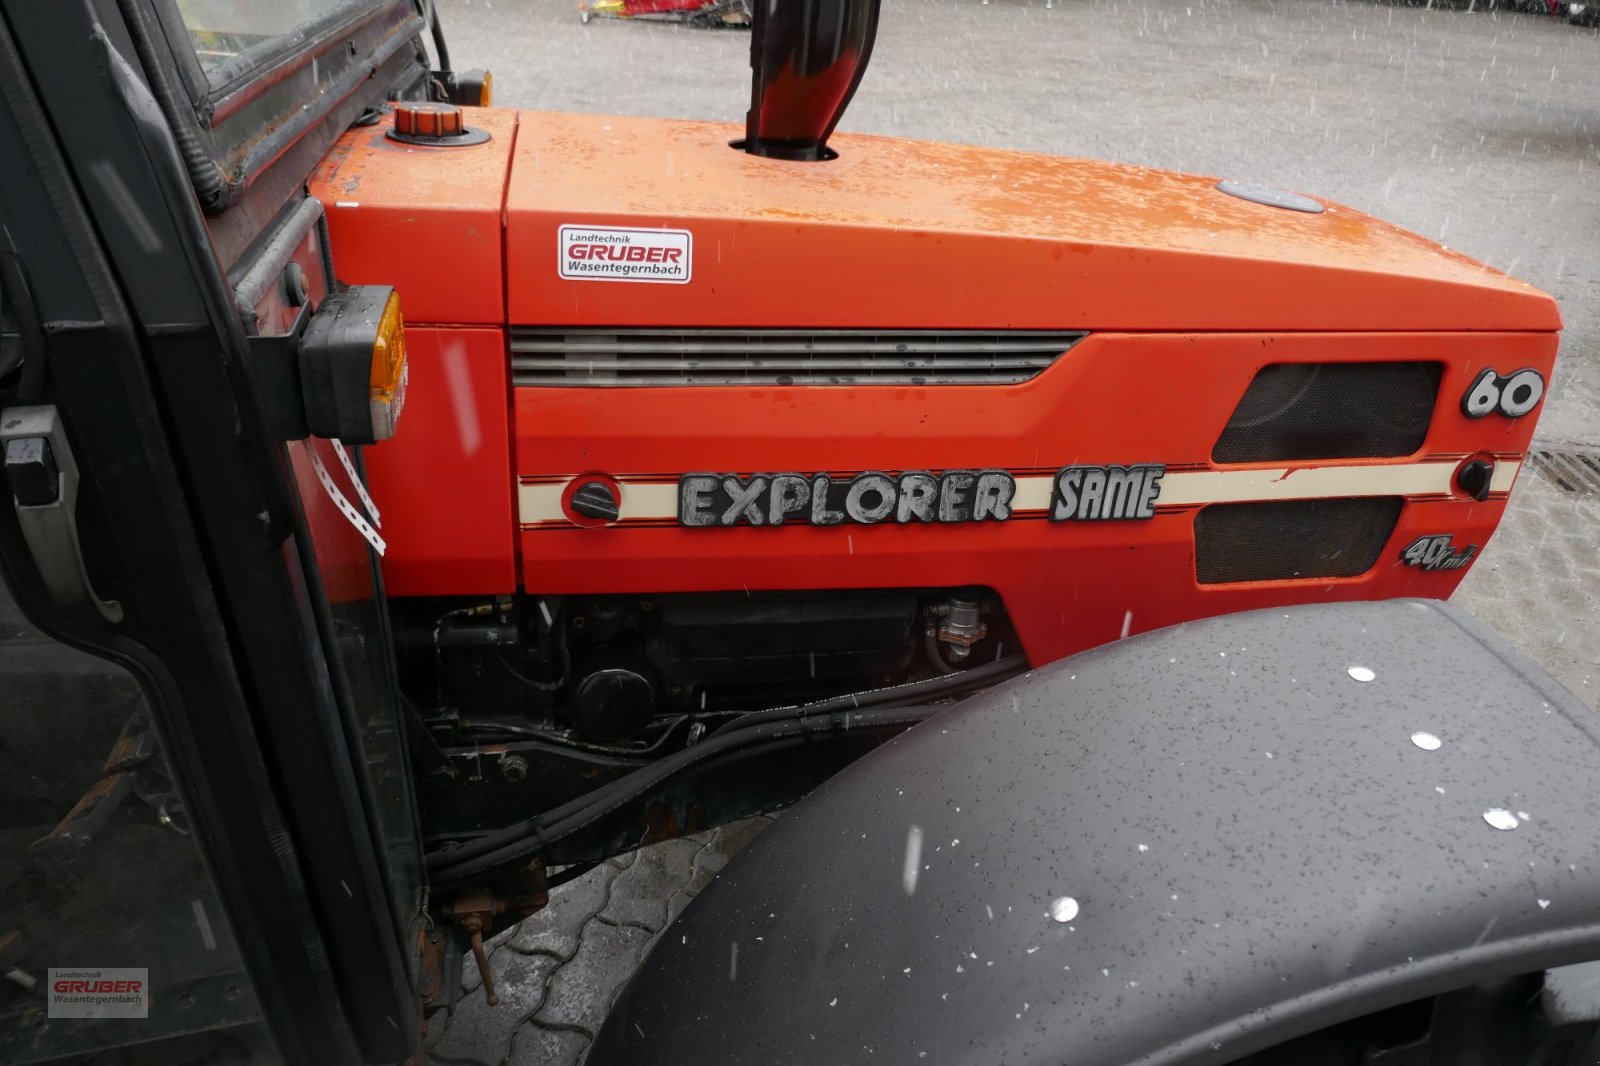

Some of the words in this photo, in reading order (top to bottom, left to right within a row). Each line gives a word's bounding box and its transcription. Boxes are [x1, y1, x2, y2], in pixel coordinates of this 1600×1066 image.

[569, 233, 631, 244] Landtechnik
[568, 243, 683, 264] GRUBER
[568, 261, 682, 275] Wasentegernbach
[1466, 370, 1544, 417] 60
[681, 473, 1015, 527] EXPLORER
[1054, 465, 1165, 521] SAME
[1404, 536, 1452, 566] 40
